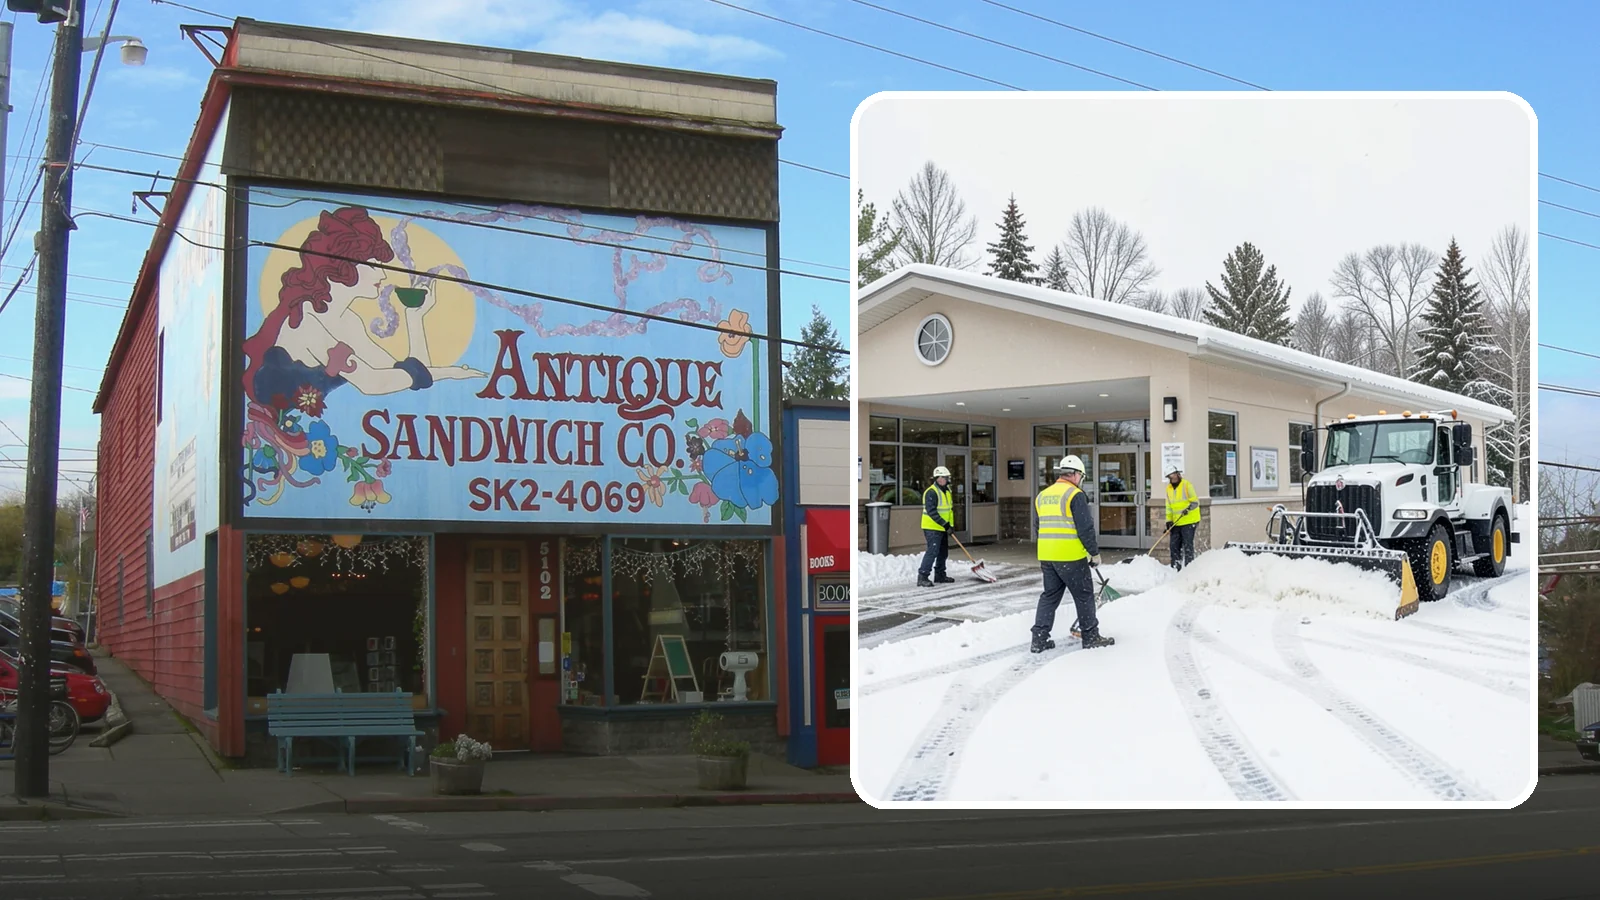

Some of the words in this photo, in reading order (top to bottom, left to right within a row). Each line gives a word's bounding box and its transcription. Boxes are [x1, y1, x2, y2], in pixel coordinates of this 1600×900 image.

[476, 329, 724, 421] ANTIQUE
[360, 408, 605, 467] SANDWICH
[617, 422, 686, 469] CO.
[468, 477, 646, 512] SK2-4069
[540, 541, 552, 600] 5102
[809, 555, 835, 569] BOOKS
